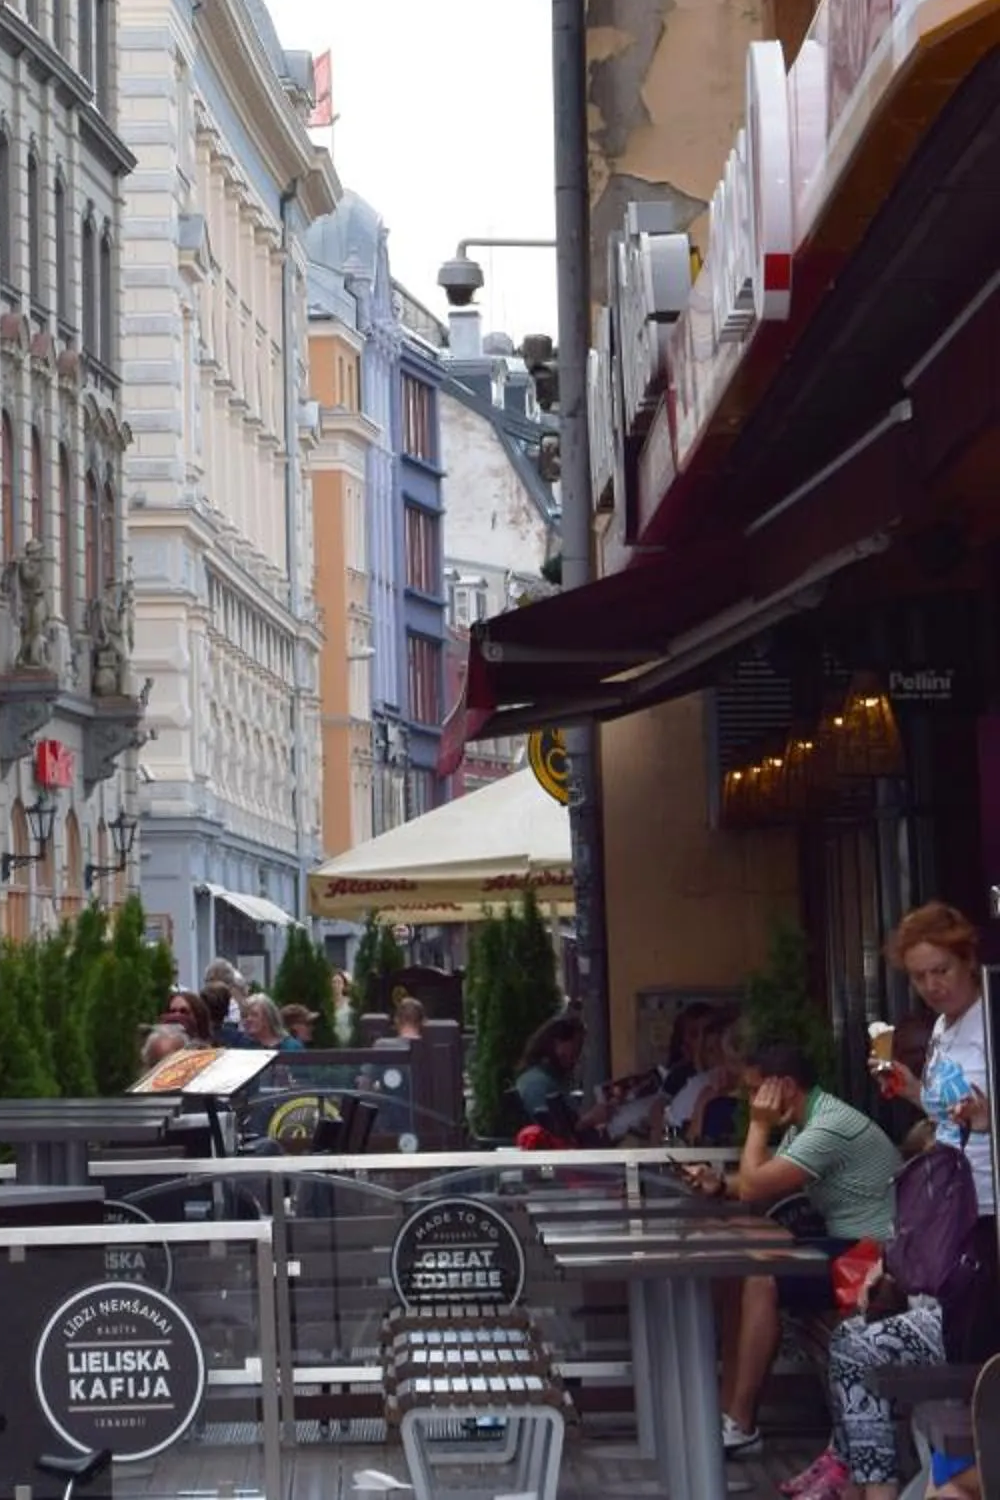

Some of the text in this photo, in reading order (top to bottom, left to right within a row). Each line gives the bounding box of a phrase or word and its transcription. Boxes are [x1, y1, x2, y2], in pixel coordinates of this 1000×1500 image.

[889, 670, 952, 690] Pellini
[416, 1211, 499, 1239] MADE TO GO
[421, 1250, 493, 1268] GREAT
[63, 1305, 96, 1339] LĪDZI
[68, 1349, 170, 1373] LIELISKA
[69, 1376, 170, 1400] KAFIJA
